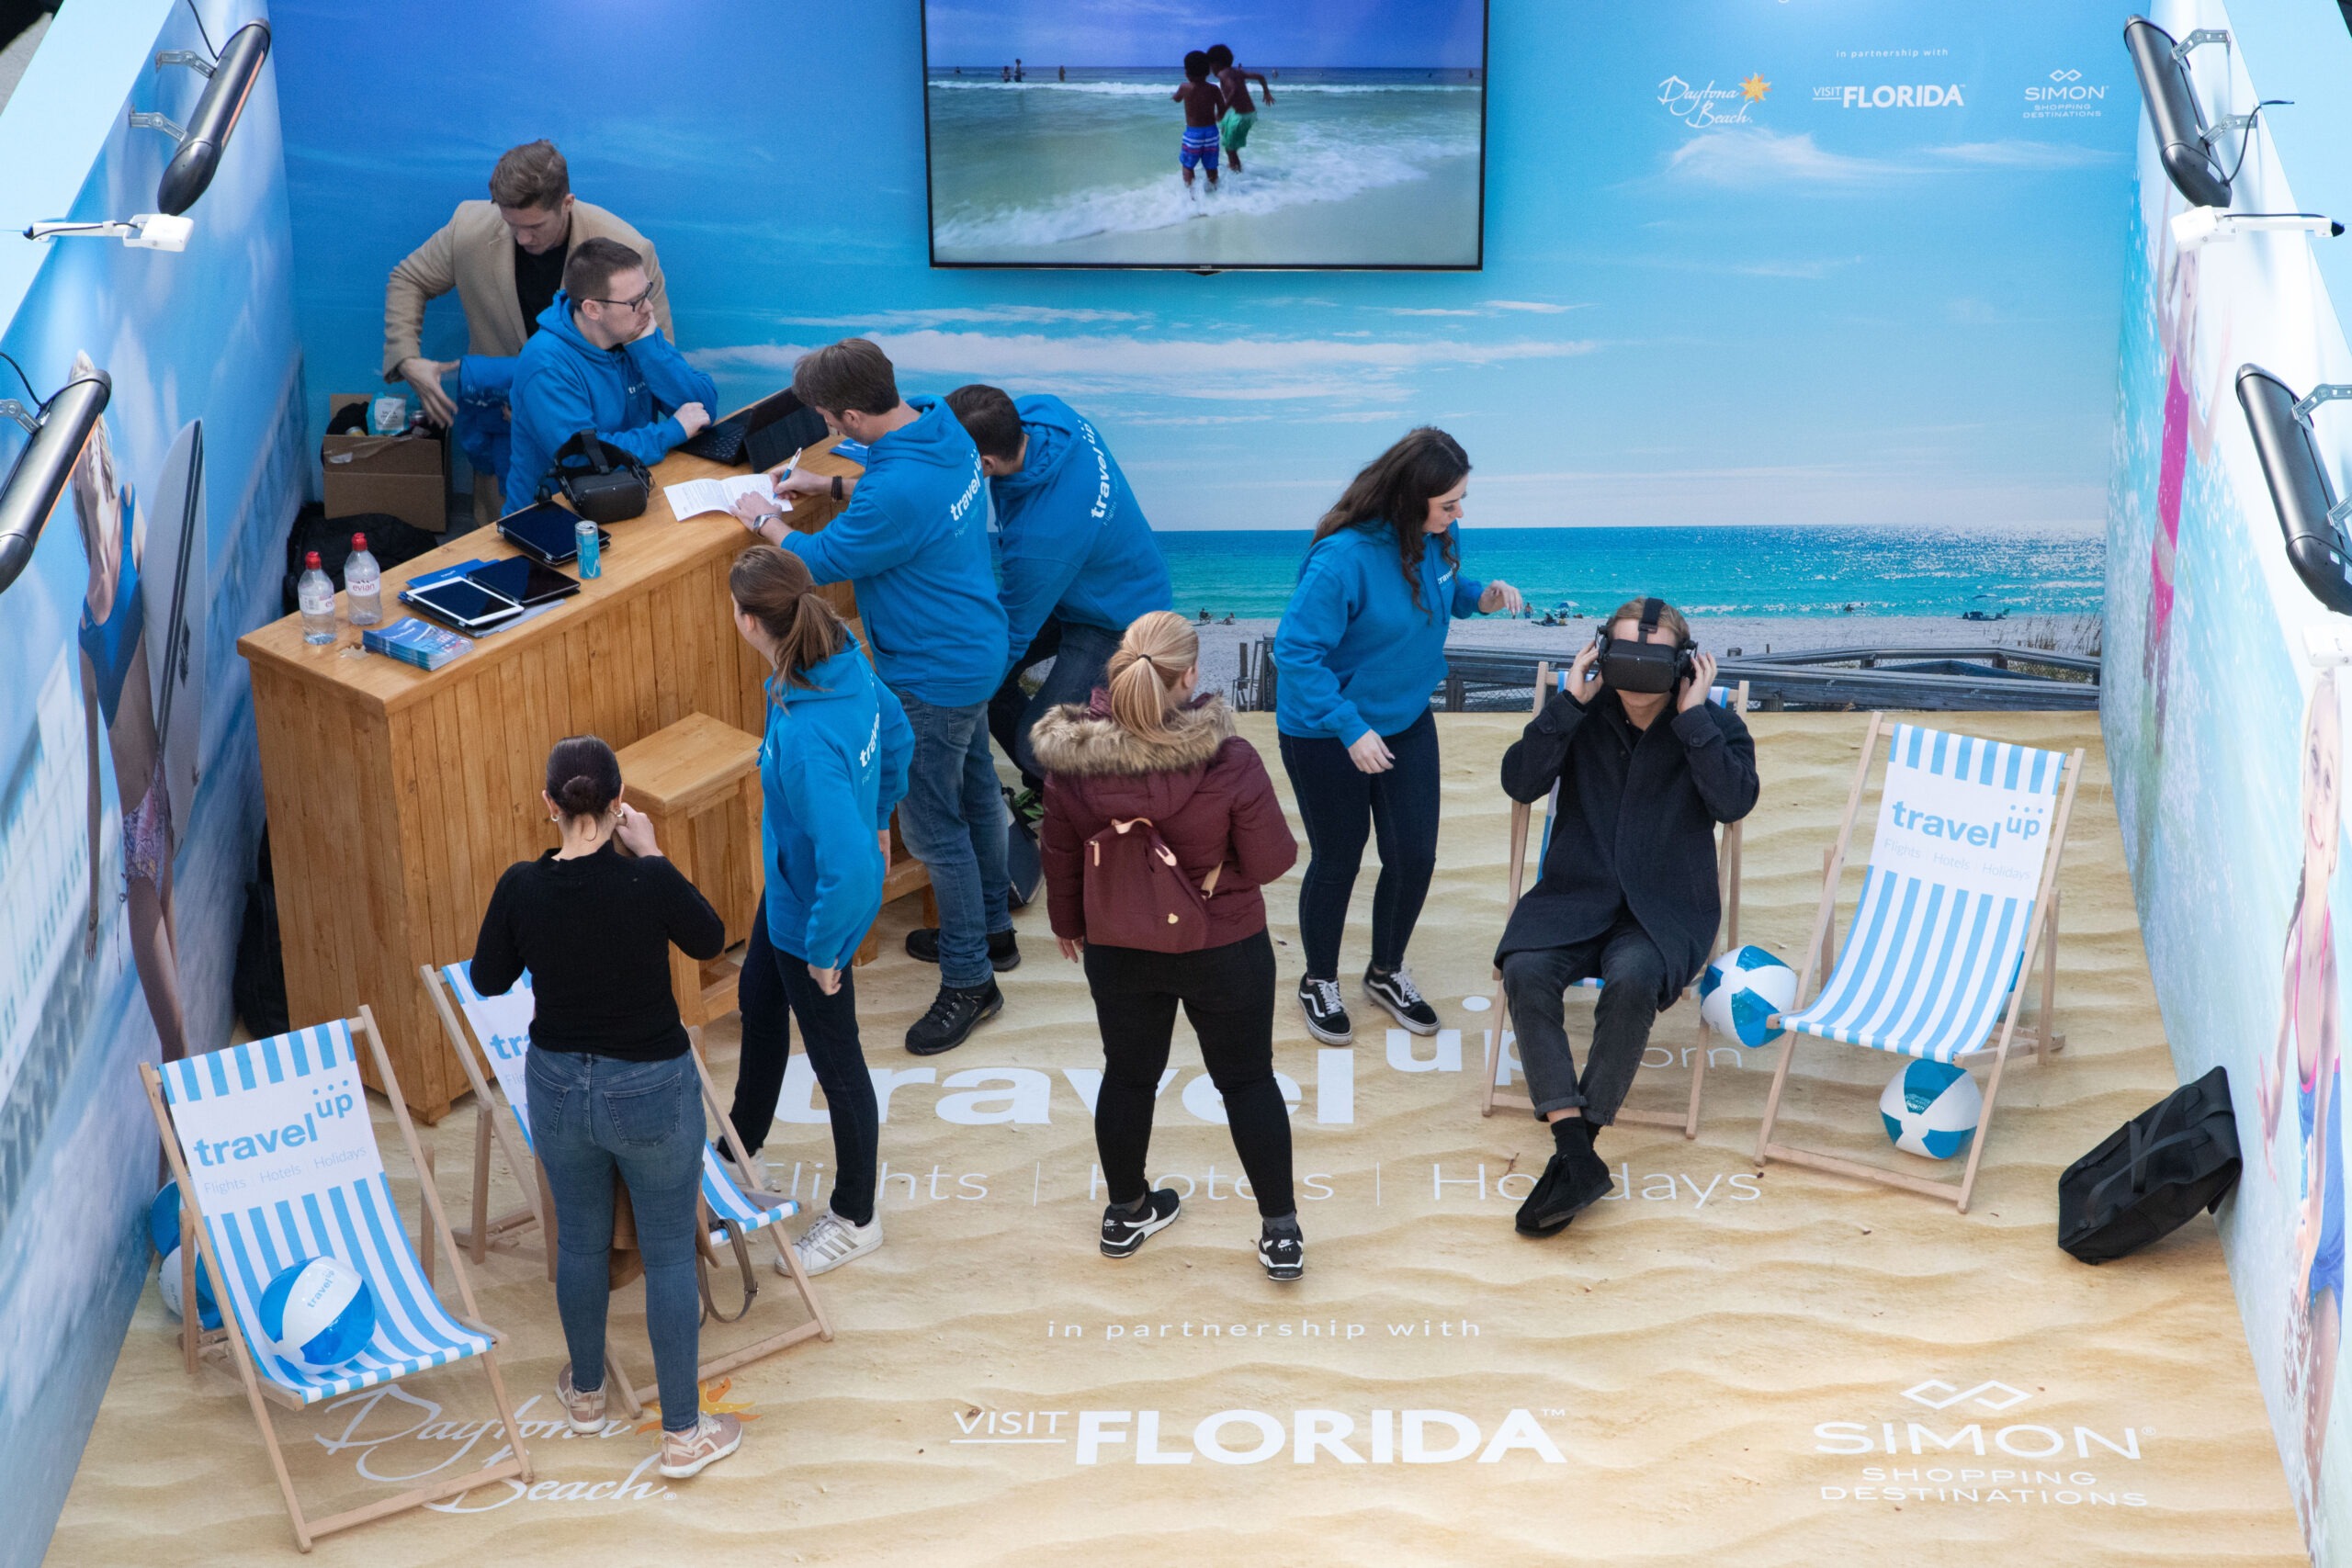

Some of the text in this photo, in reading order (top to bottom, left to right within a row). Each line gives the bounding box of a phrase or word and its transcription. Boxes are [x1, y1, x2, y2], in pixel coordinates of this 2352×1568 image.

[1836, 49, 1949, 59] in partnership with
[1657, 75, 1739, 117] Daytona
[1813, 87, 1842, 96] VISIT
[2022, 110, 2102, 118] DESTINATIONS
[2034, 103, 2092, 111] SHOPPING
[950, 469, 981, 522] travel
[1091, 446, 1110, 519] travel
[352, 582, 376, 592] evian
[1891, 800, 2001, 850] travel
[1884, 838, 2031, 882] Flights Hotels Holidays
[193, 1113, 318, 1168] travel
[203, 1145, 368, 1196] Flights Hotels Holidays
[1433, 1162, 1762, 1209] Hodays
[307, 1277, 334, 1309] travel
[1047, 1319, 1481, 1341] in partnership with
[954, 1411, 1069, 1435] VISIT
[1861, 1467, 2098, 1485] SHOPPING
[1821, 1486, 2149, 1507] DESTINATIONS
